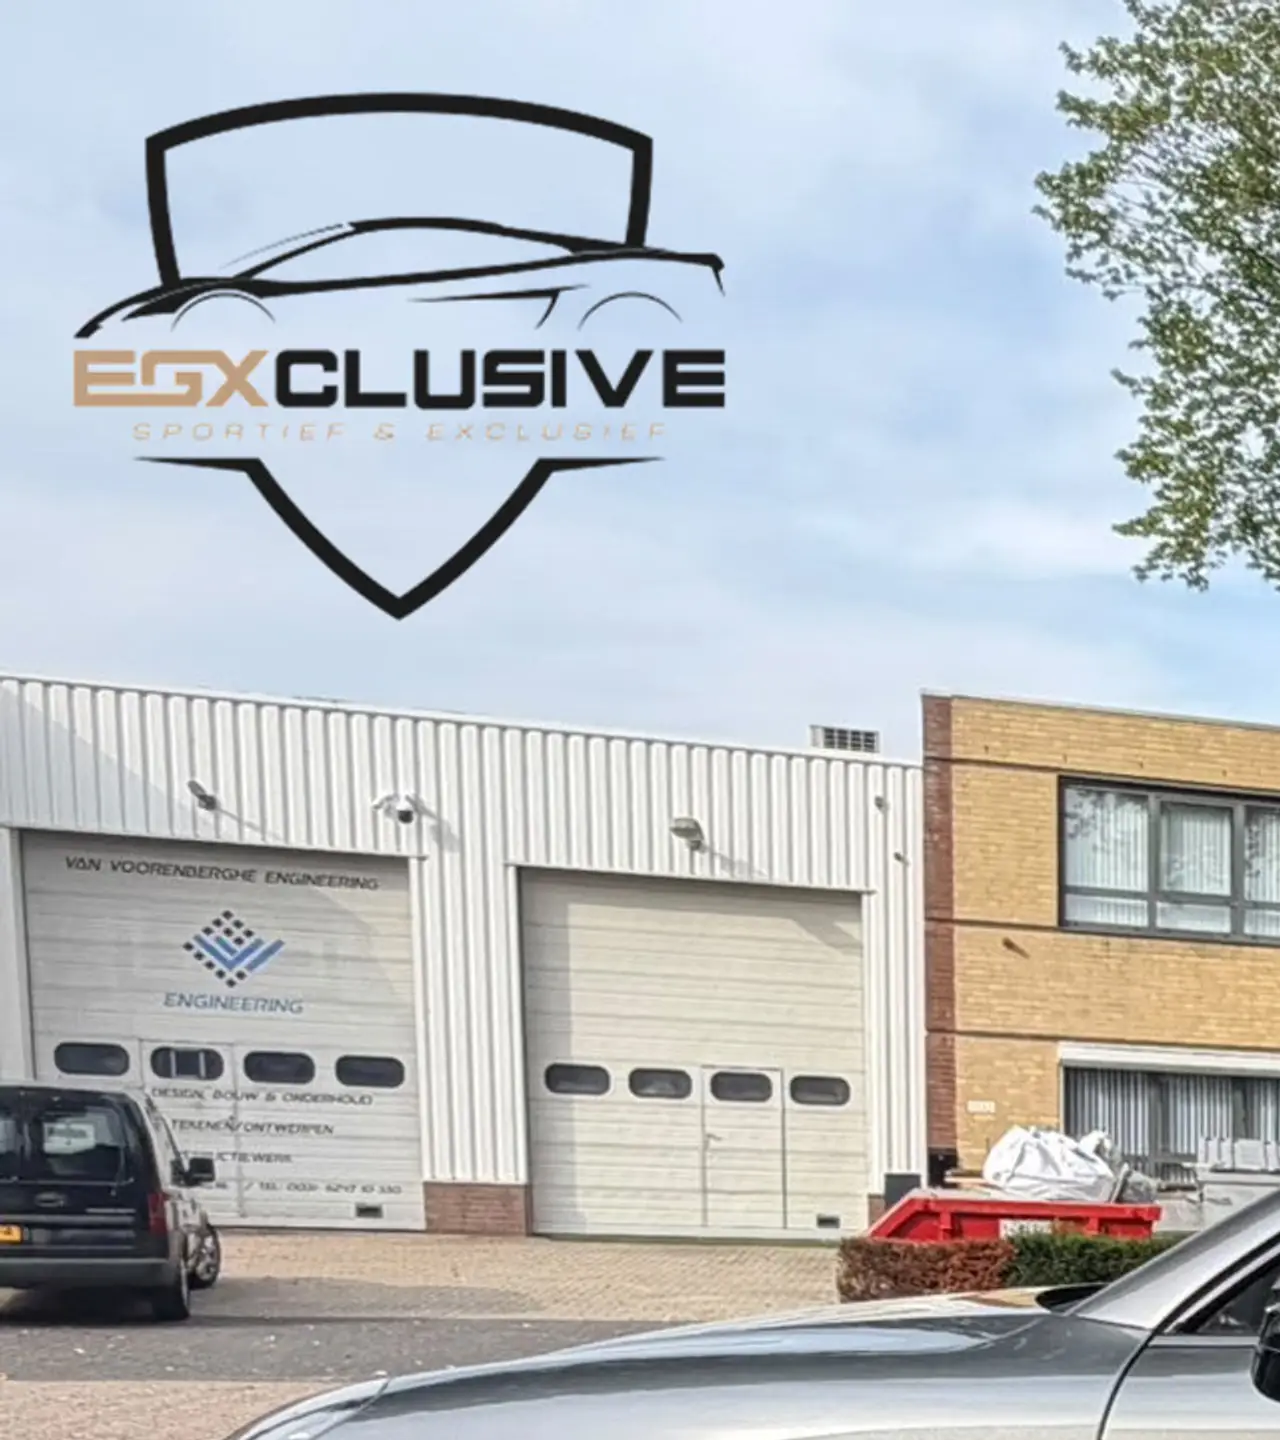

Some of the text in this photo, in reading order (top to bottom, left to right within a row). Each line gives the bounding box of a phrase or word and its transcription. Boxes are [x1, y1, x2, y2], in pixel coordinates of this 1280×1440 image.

[65, 855, 380, 891] VAN VOORENBERGHE ENGINEERING
[163, 991, 304, 1015] ENGINEERING
[212, 1089, 260, 1102] BOUW
[281, 1092, 373, 1106] ONDERHOUD
